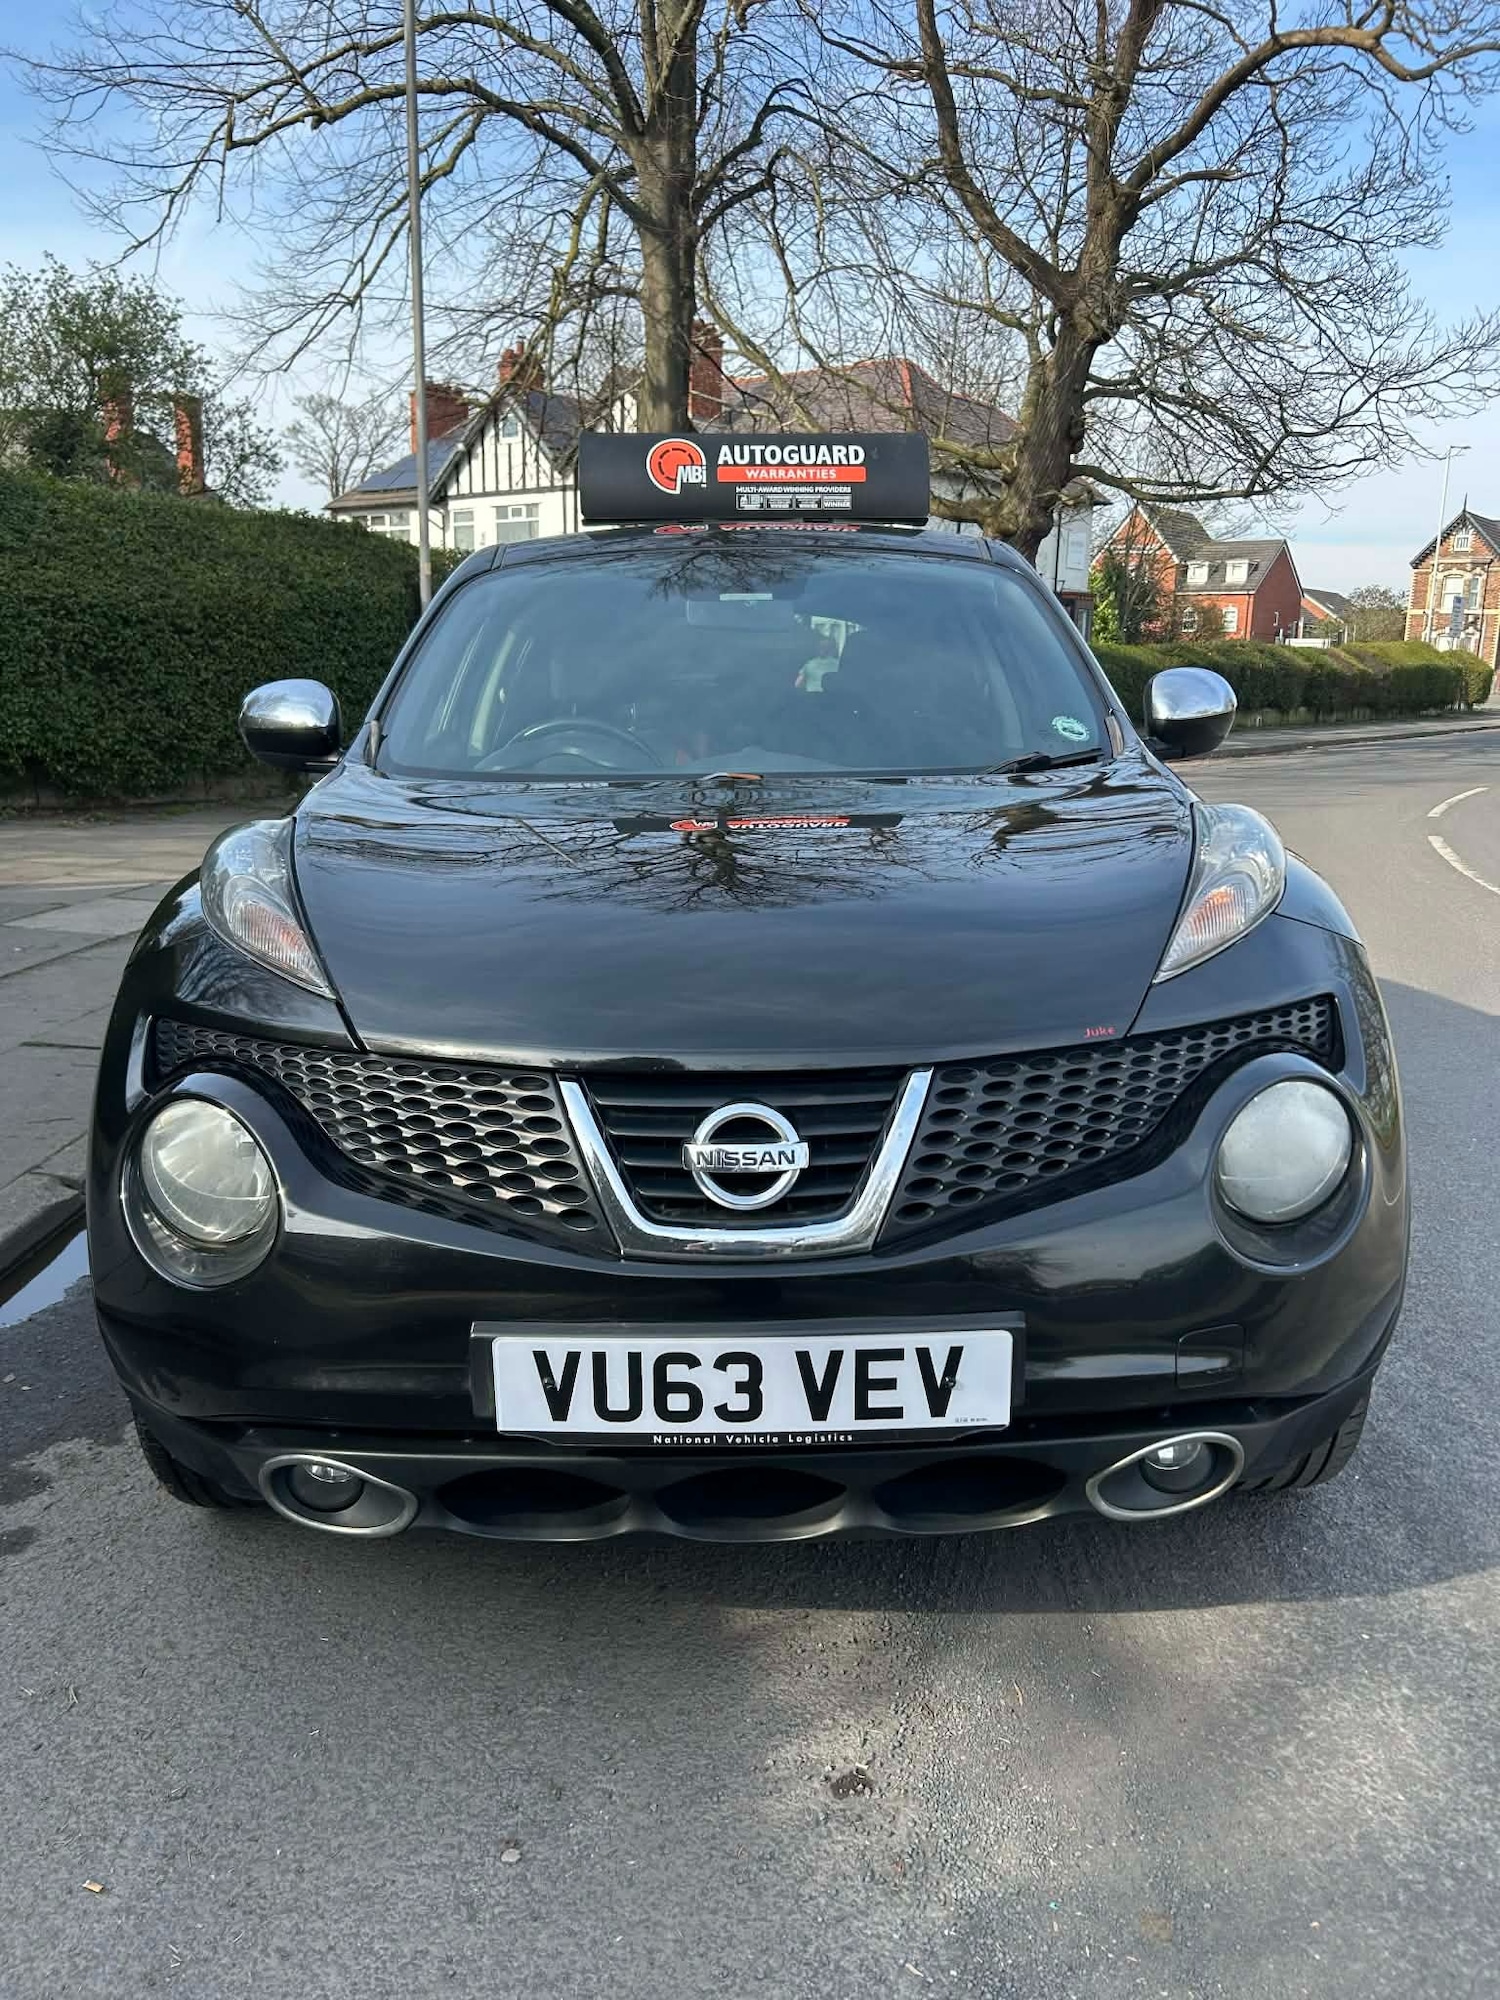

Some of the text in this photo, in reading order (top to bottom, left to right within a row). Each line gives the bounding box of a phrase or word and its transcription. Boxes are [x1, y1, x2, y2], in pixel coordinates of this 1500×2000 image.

[717, 444, 866, 465] AUTOGUARD
[745, 468, 837, 479] WARRANTIES
[735, 485, 783, 493] MULTI-AWARD
[814, 485, 852, 493] PROVIDERS
[696, 1149, 796, 1166] NISSAN
[532, 1345, 965, 1423] VU63 VEV
[653, 1432, 853, 1444] National Vehicle Logistics
